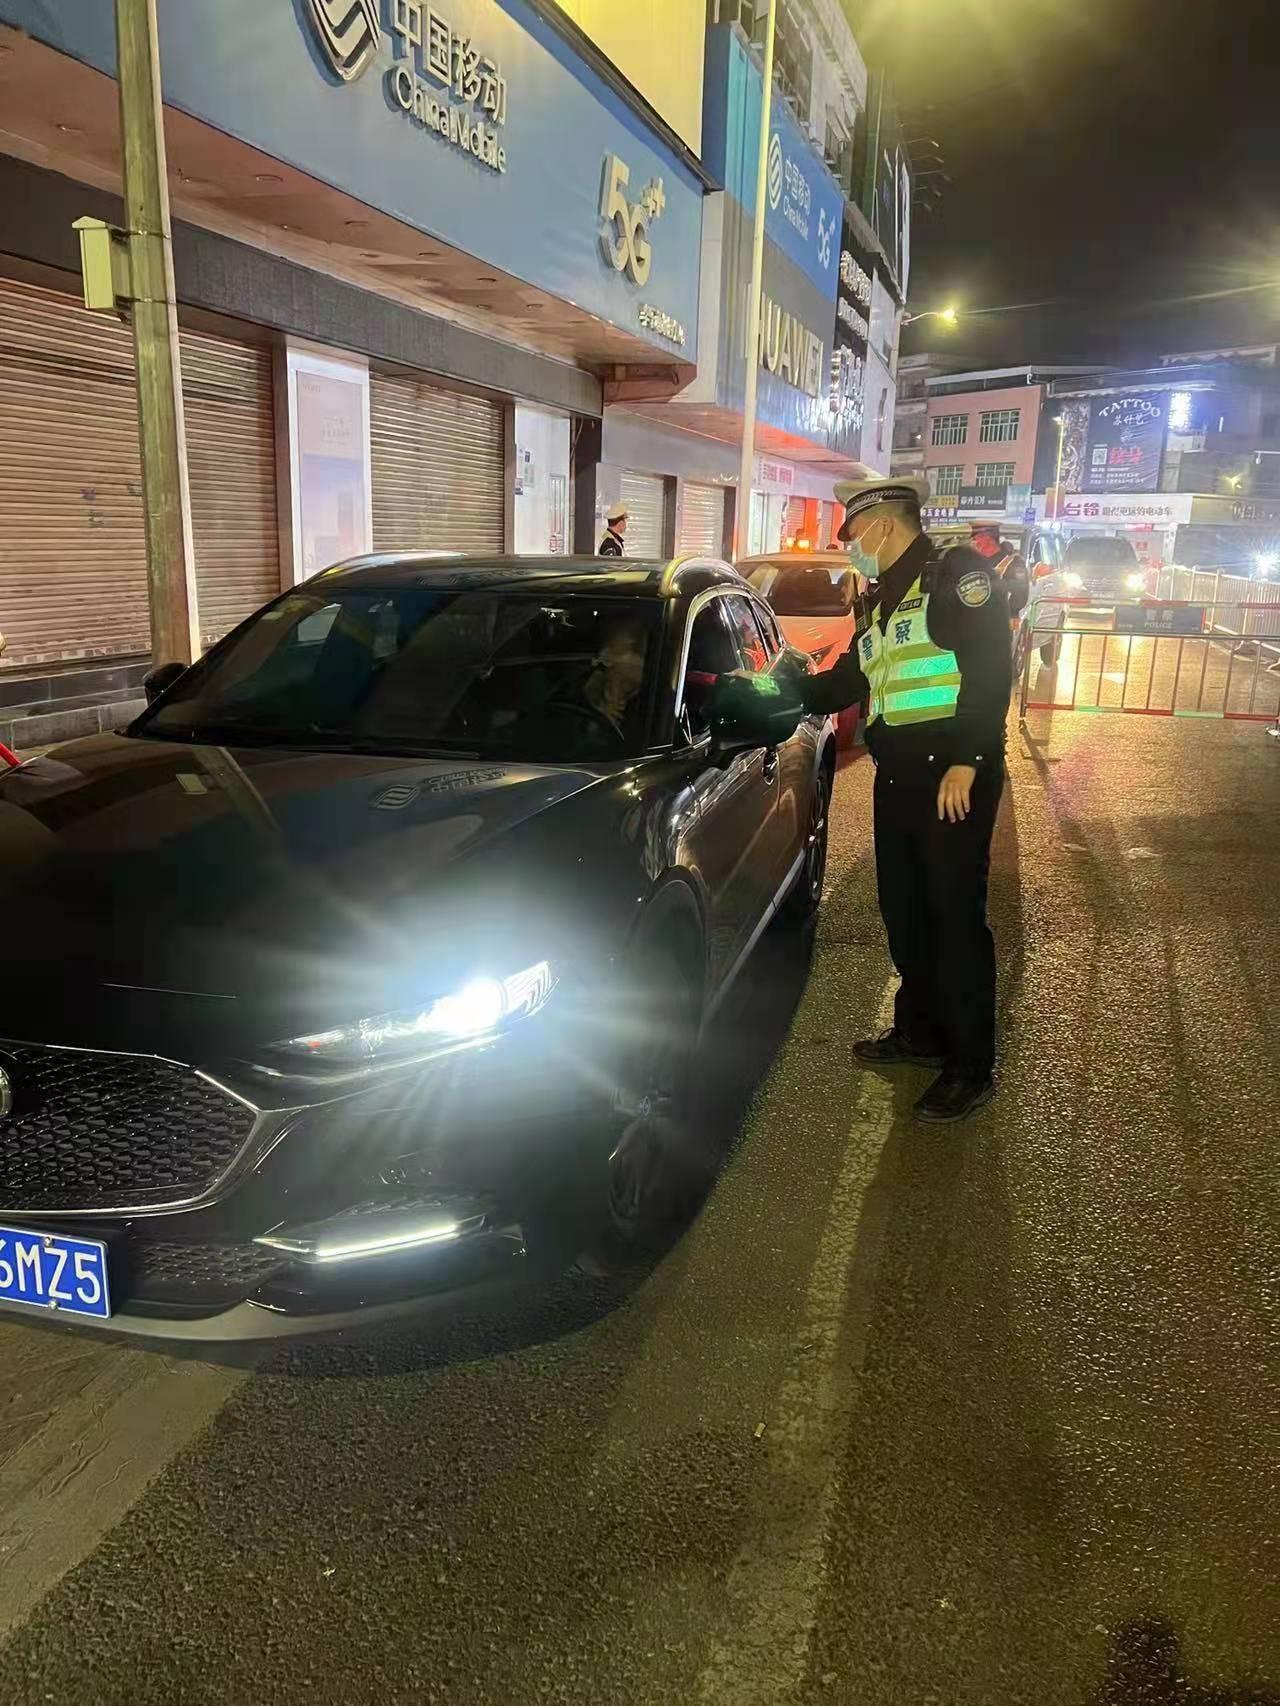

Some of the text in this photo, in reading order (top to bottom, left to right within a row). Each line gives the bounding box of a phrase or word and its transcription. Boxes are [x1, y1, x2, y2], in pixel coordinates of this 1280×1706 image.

[391, 0, 506, 125] 中国移动
[1098, 398, 1161, 417] TATTOO
[1065, 502, 1099, 516] 台铃
[895, 619, 912, 644] 察
